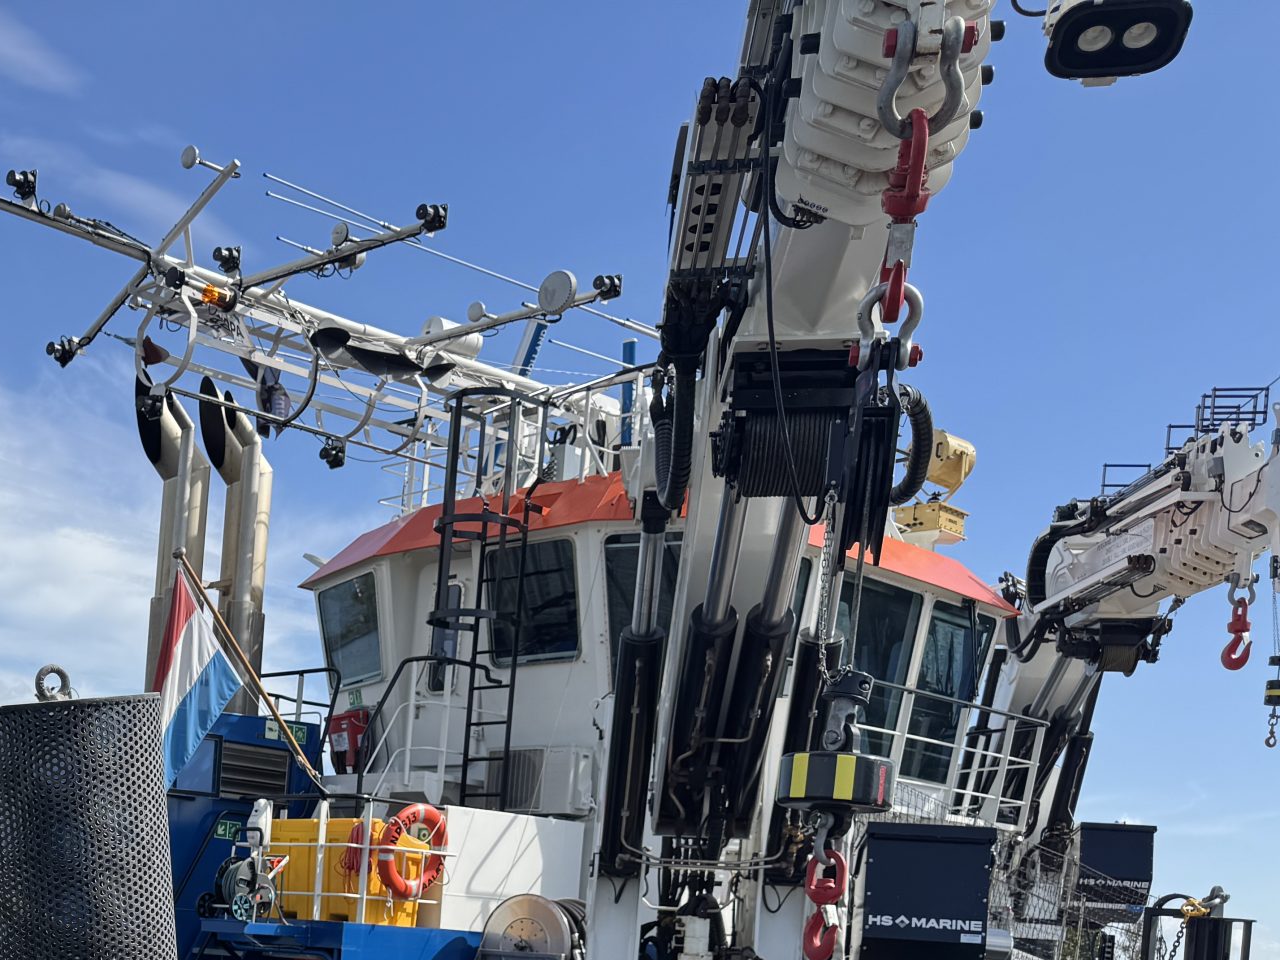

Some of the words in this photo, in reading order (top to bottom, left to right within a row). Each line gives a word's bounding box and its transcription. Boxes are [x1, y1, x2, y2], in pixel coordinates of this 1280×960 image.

[1105, 879, 1149, 889] MARINE
[867, 914, 894, 927] HS
[911, 917, 983, 932] MARINE
